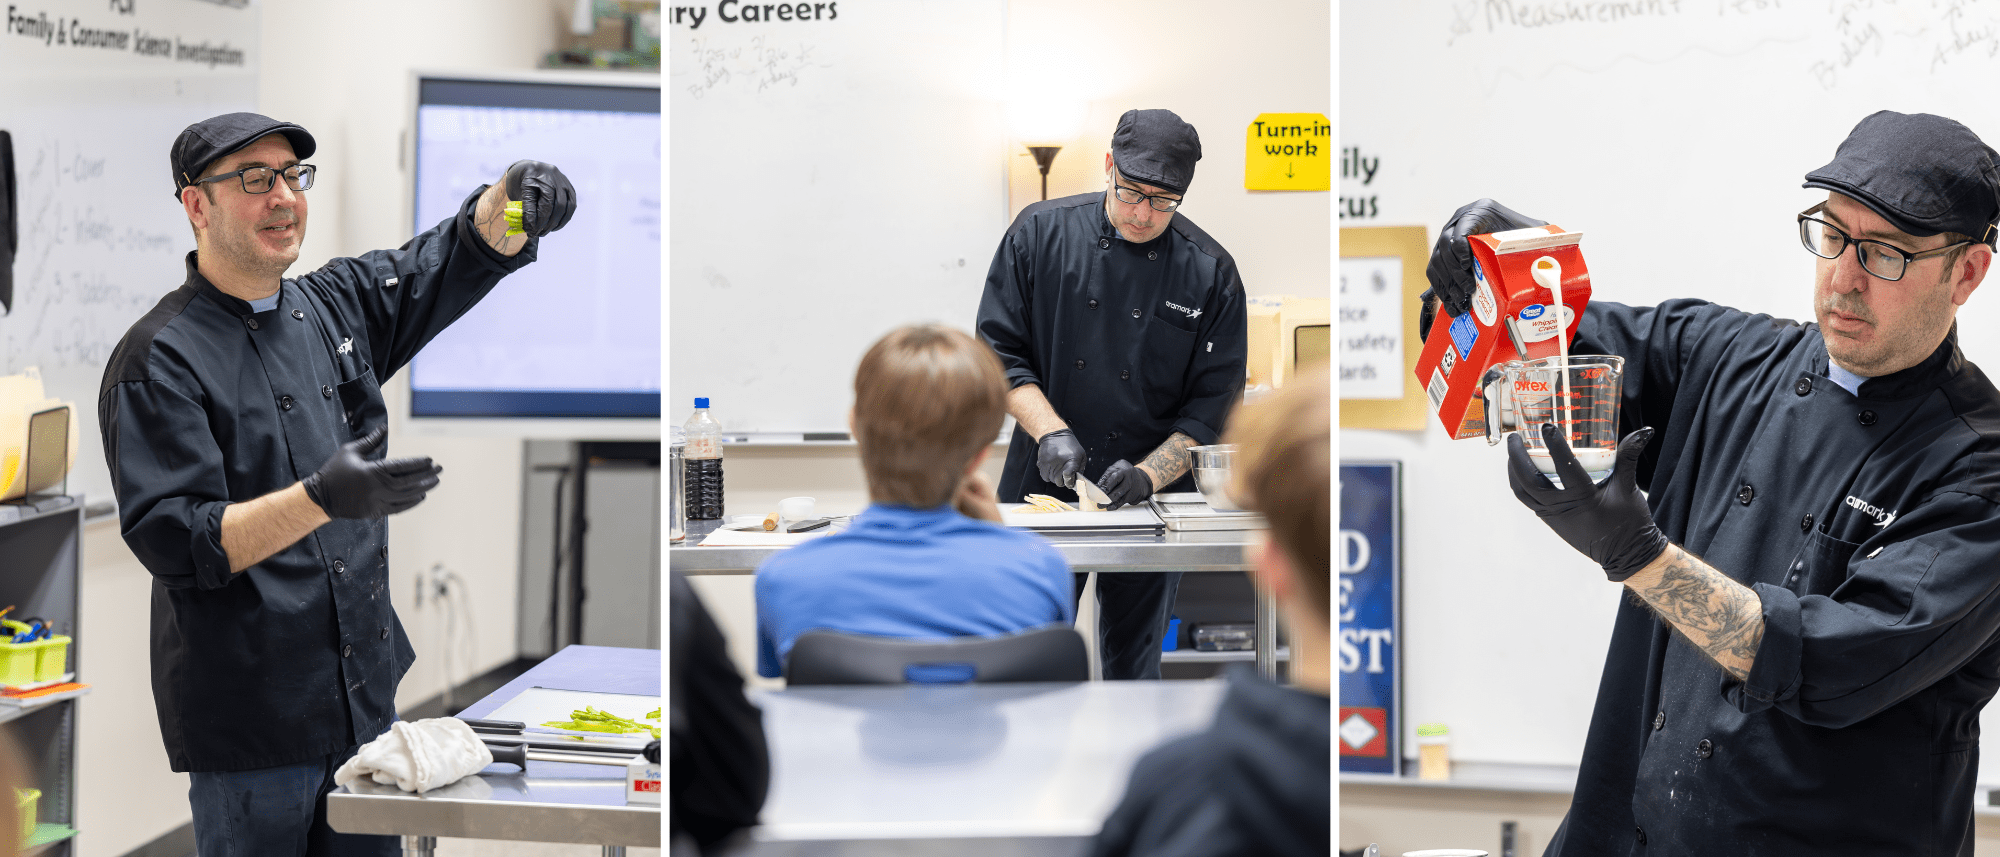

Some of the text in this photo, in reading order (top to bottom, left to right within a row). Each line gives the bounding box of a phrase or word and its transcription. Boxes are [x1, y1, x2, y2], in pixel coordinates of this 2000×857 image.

[669, 0, 838, 30] ry Careers
[8, 6, 244, 69] Family & Consumer Science Investigations
[1254, 120, 1331, 137] Turn-in
[1264, 139, 1318, 156] work
[1165, 300, 1192, 315] aramark
[1348, 335, 1397, 356] safety
[1514, 380, 1549, 393] pyrex
